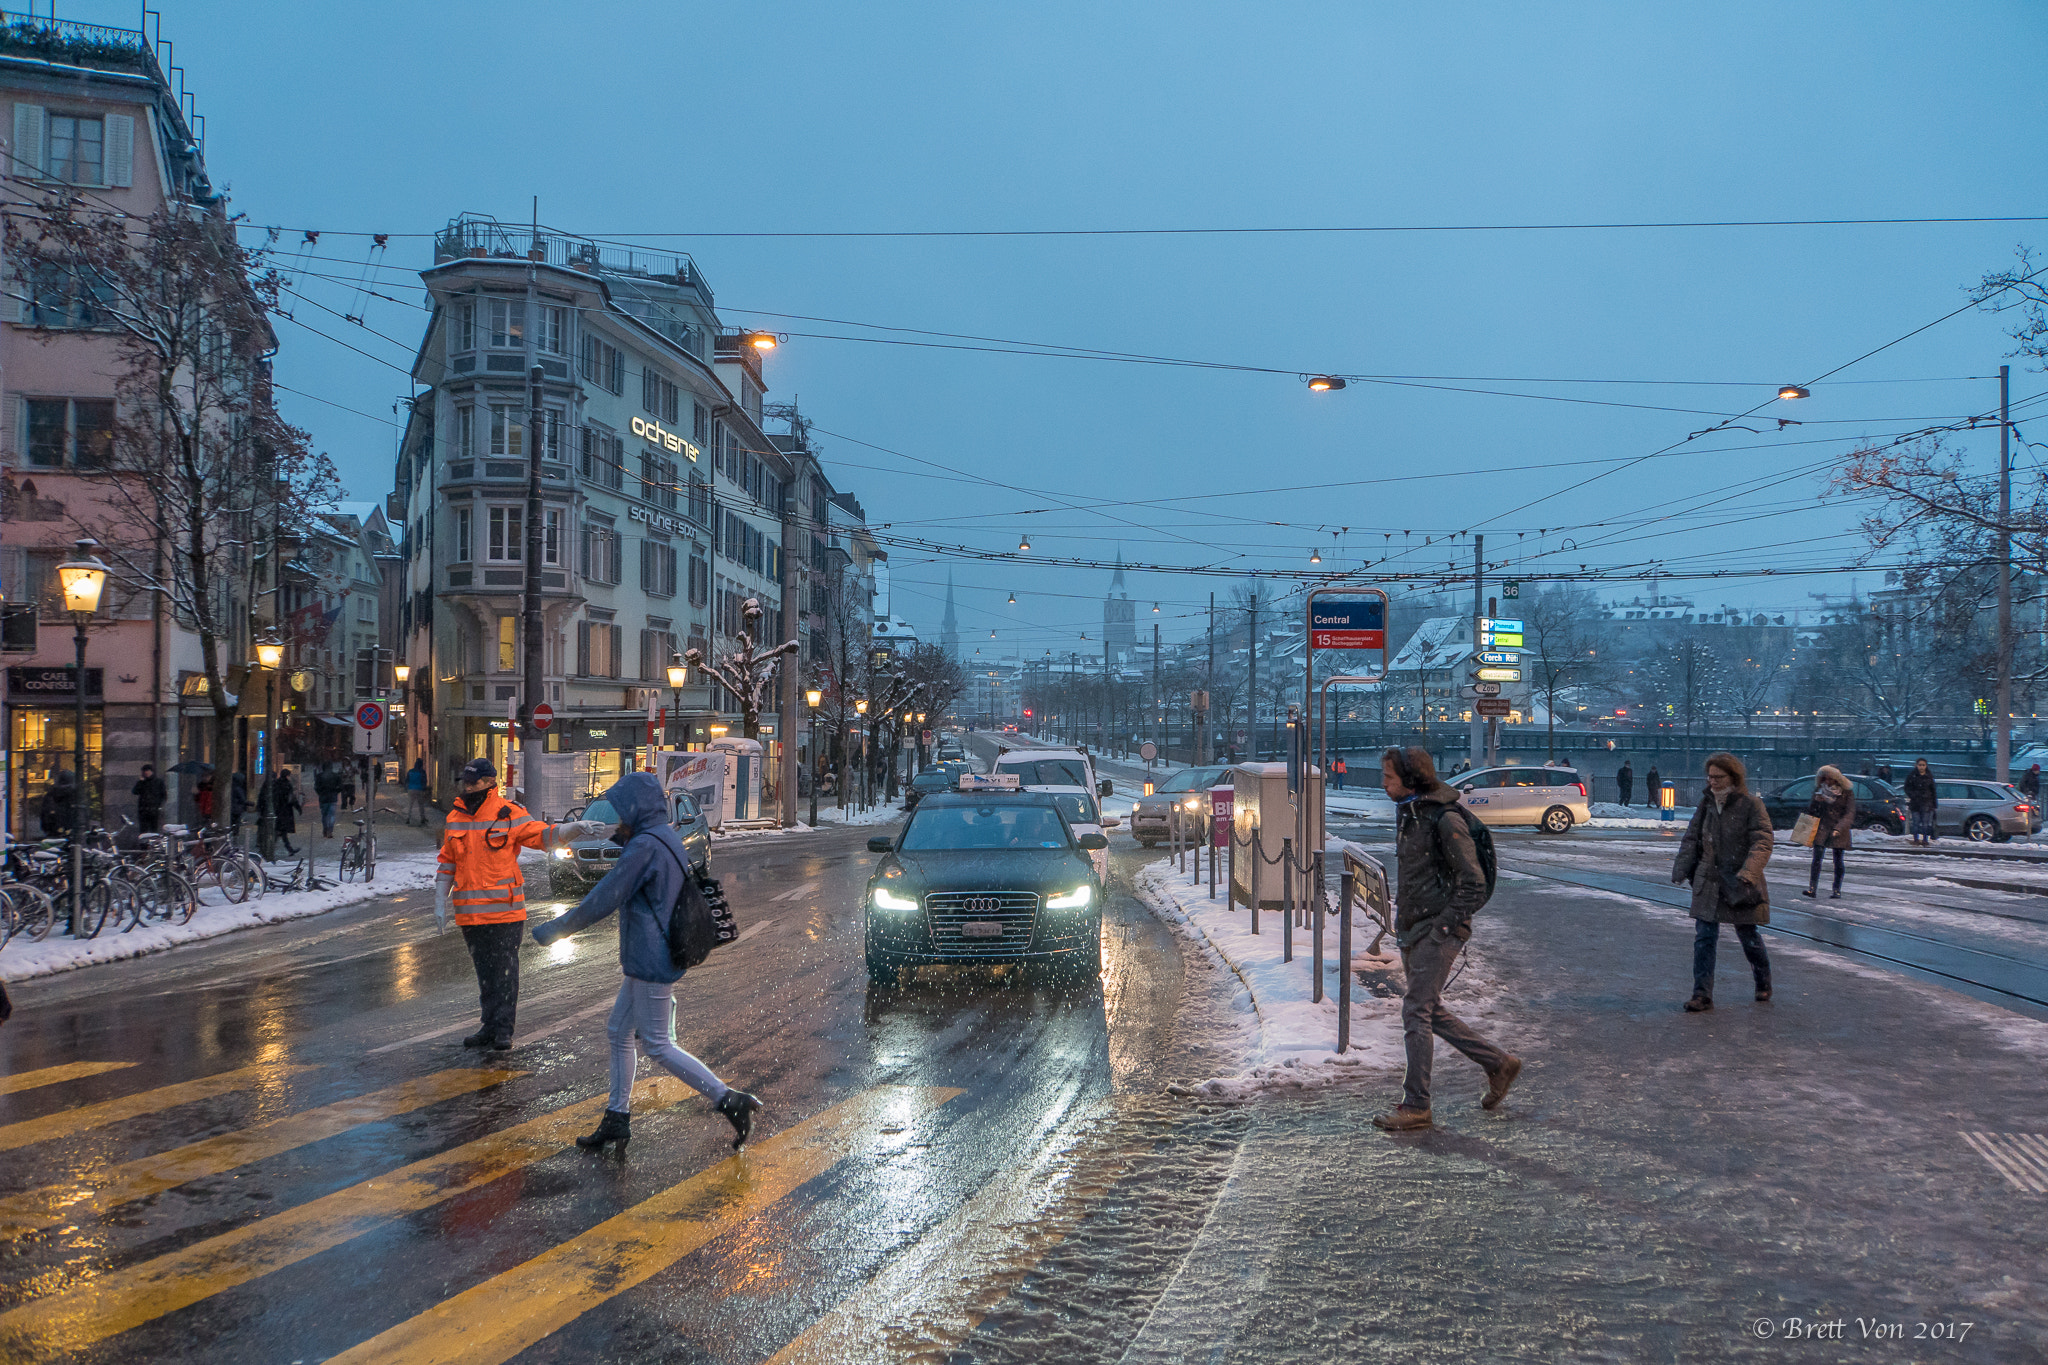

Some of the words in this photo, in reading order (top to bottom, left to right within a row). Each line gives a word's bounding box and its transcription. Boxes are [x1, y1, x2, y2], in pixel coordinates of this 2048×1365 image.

[630, 416, 699, 463] ochsner
[1503, 586, 1518, 597] 36
[1314, 615, 1350, 624] Central
[1316, 634, 1331, 646] 15
[1484, 653, 1503, 662] Forch
[25, 681, 77, 690] CONFISER
